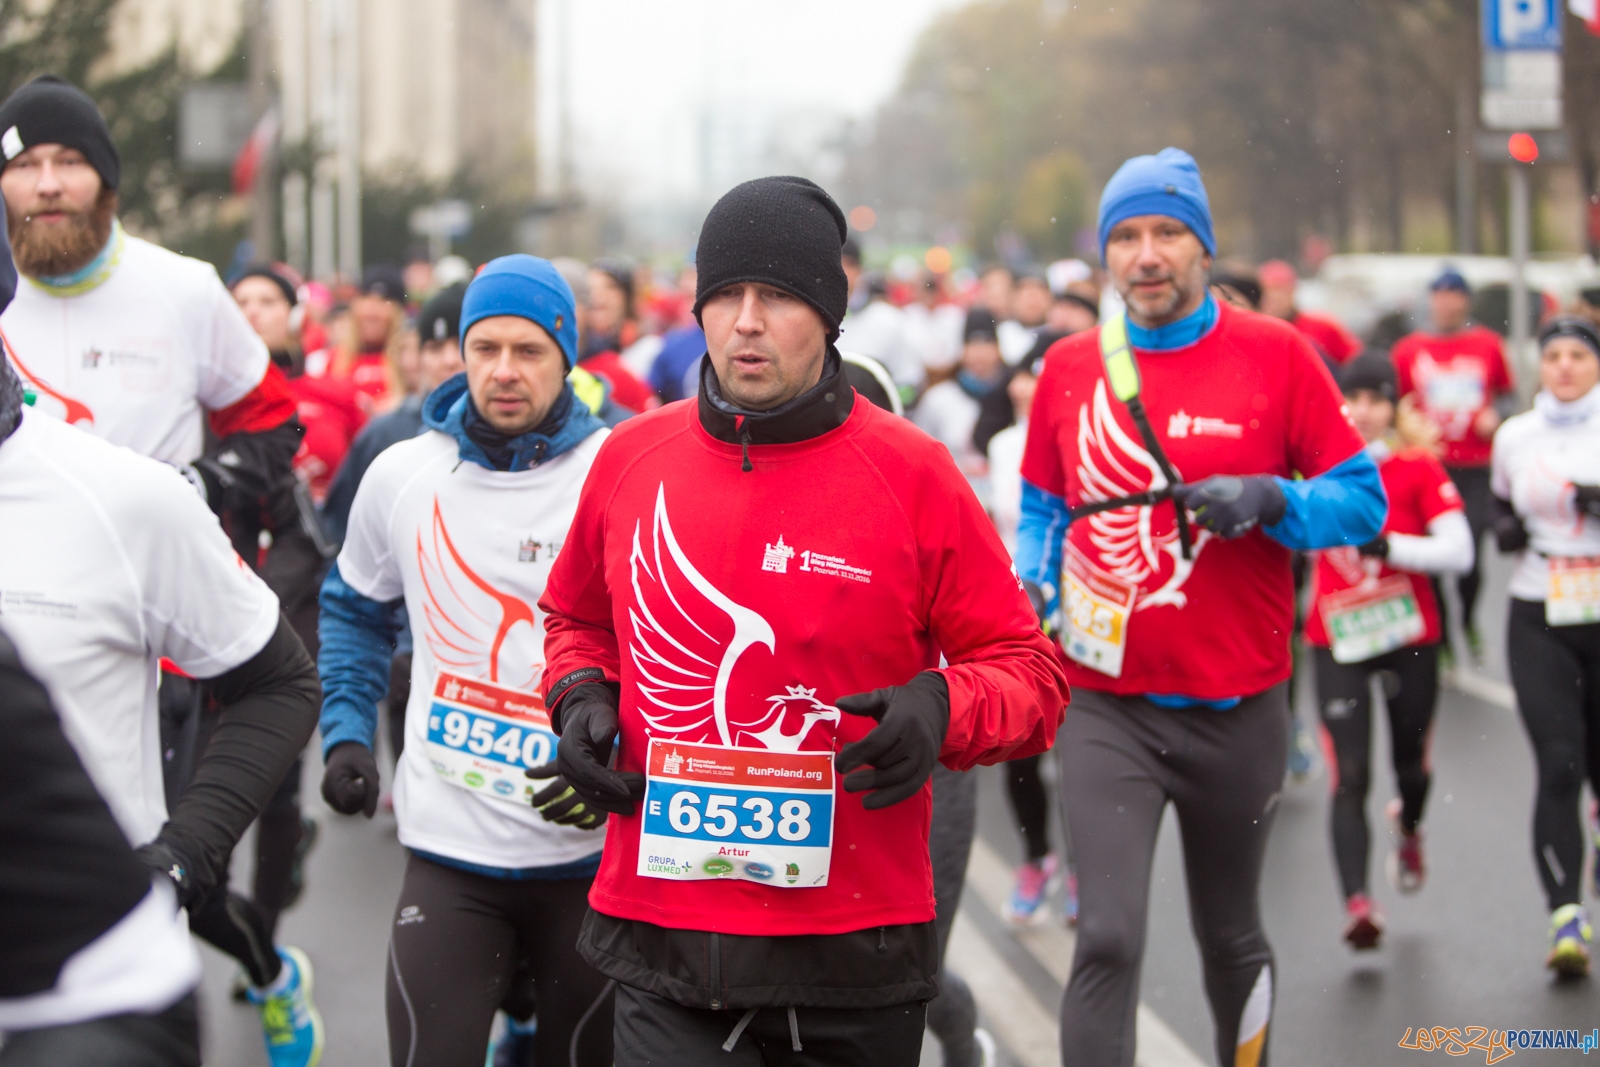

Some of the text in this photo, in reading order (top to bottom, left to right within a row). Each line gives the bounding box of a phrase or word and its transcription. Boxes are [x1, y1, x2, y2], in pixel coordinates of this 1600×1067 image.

[1499, 0, 1547, 42] P
[799, 550, 811, 572] 1
[443, 711, 551, 768] 9540
[686, 757, 694, 772] 1
[747, 766, 822, 781] RunPoland.org
[649, 790, 812, 842] E 6538
[718, 846, 750, 857] Artur
[648, 855, 676, 866] GRUPA
[647, 864, 681, 875] LUXMED
